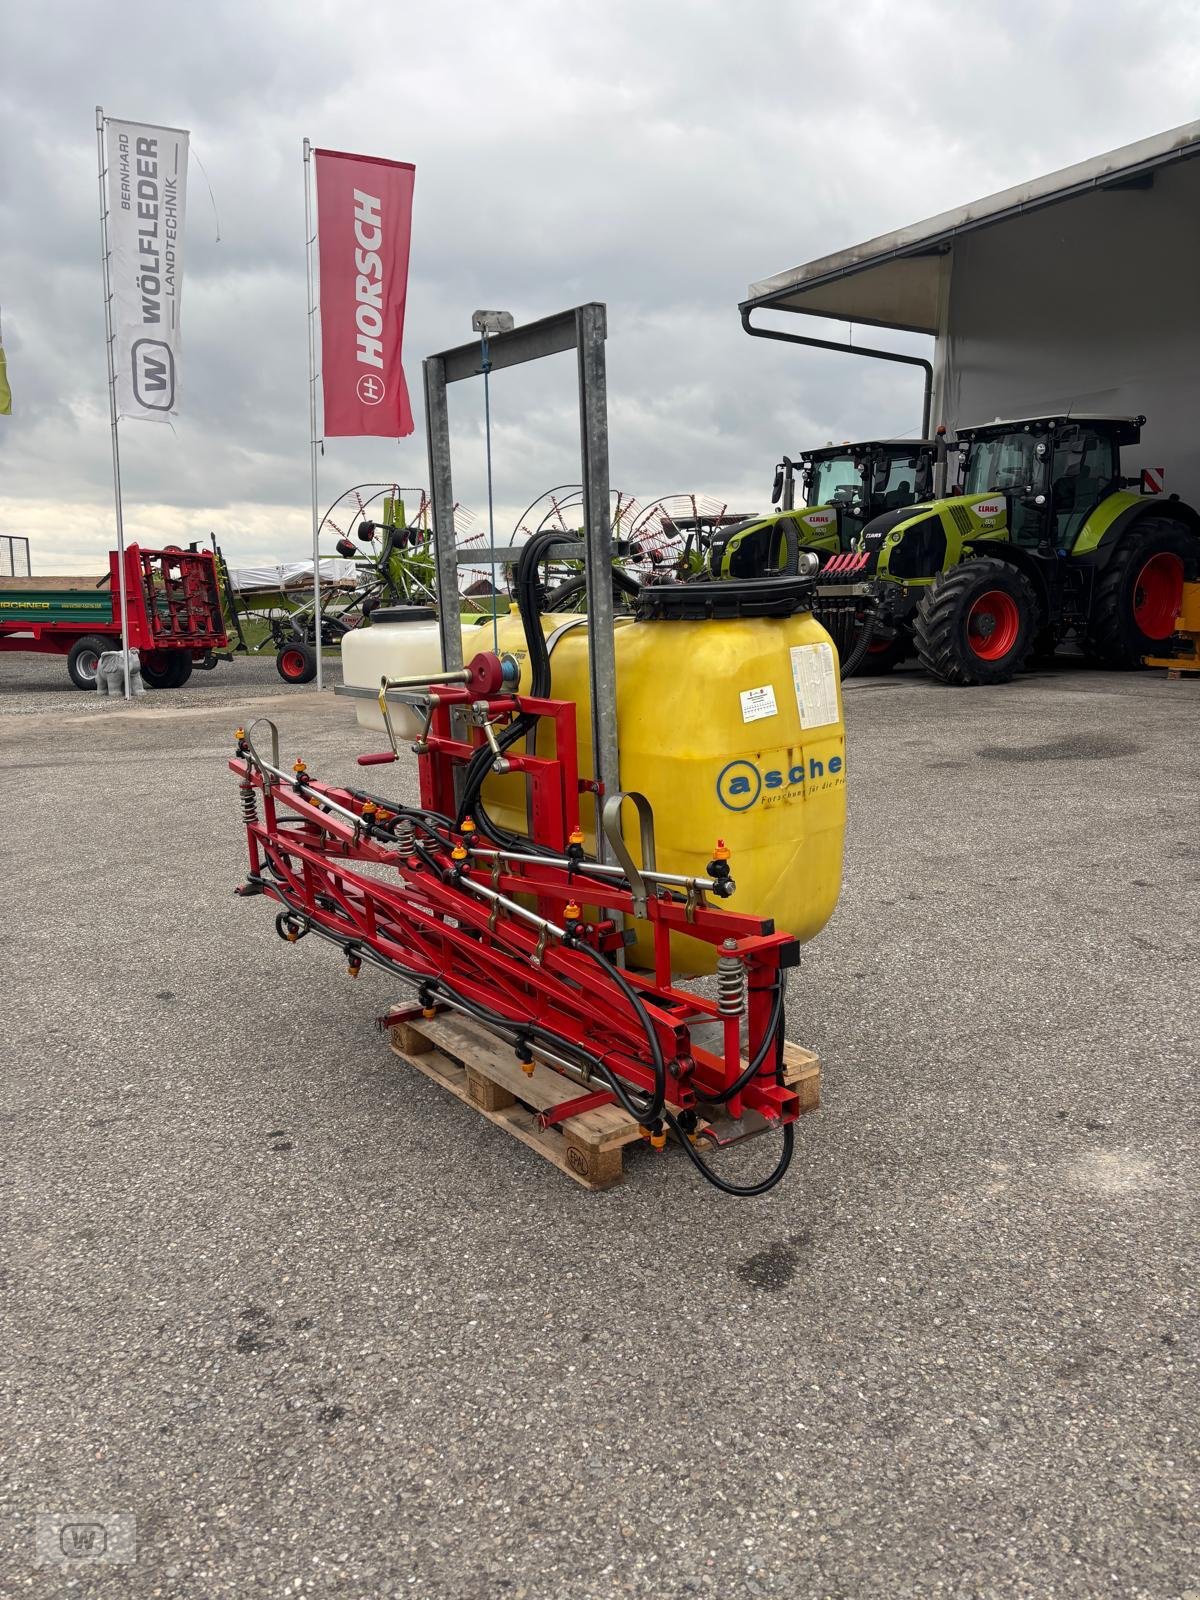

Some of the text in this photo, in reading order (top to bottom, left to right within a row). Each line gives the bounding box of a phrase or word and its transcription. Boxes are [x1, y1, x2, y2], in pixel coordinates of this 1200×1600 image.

[119, 133, 131, 210] BERNHARD
[136, 136, 161, 324] WÖLFLEDER
[164, 177, 177, 296] LANDTECHNIK
[353, 188, 384, 369] HORSCH
[143, 355, 166, 391] W
[979, 505, 998, 513] CLAAS
[0, 601, 49, 609] IRCHNER
[808, 785, 819, 796] für
[822, 781, 833, 790] die
